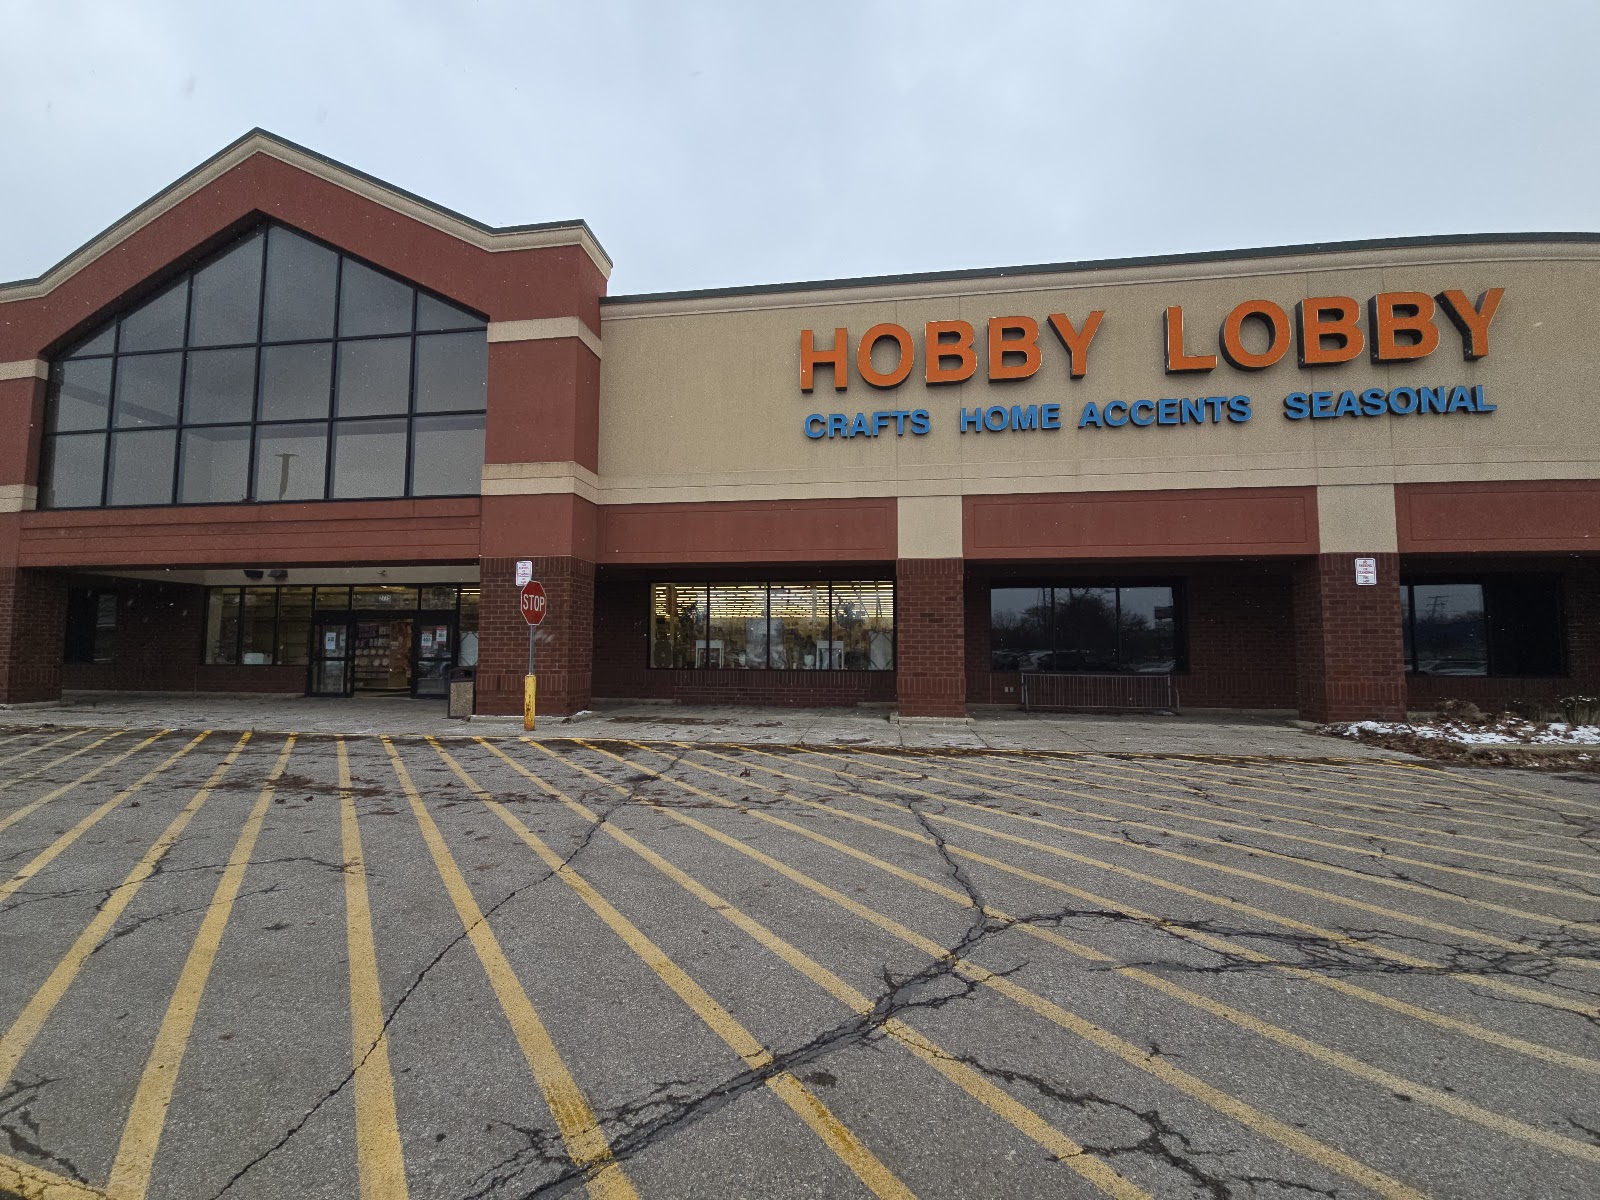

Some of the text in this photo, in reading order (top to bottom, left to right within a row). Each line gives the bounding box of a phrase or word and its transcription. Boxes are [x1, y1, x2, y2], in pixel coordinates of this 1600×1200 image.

[799, 287, 1506, 393] HOBBY LOBBY
[804, 385, 1497, 439] CRAFTS HOME ACCENTS SEASONAL
[522, 593, 545, 612] STOP
